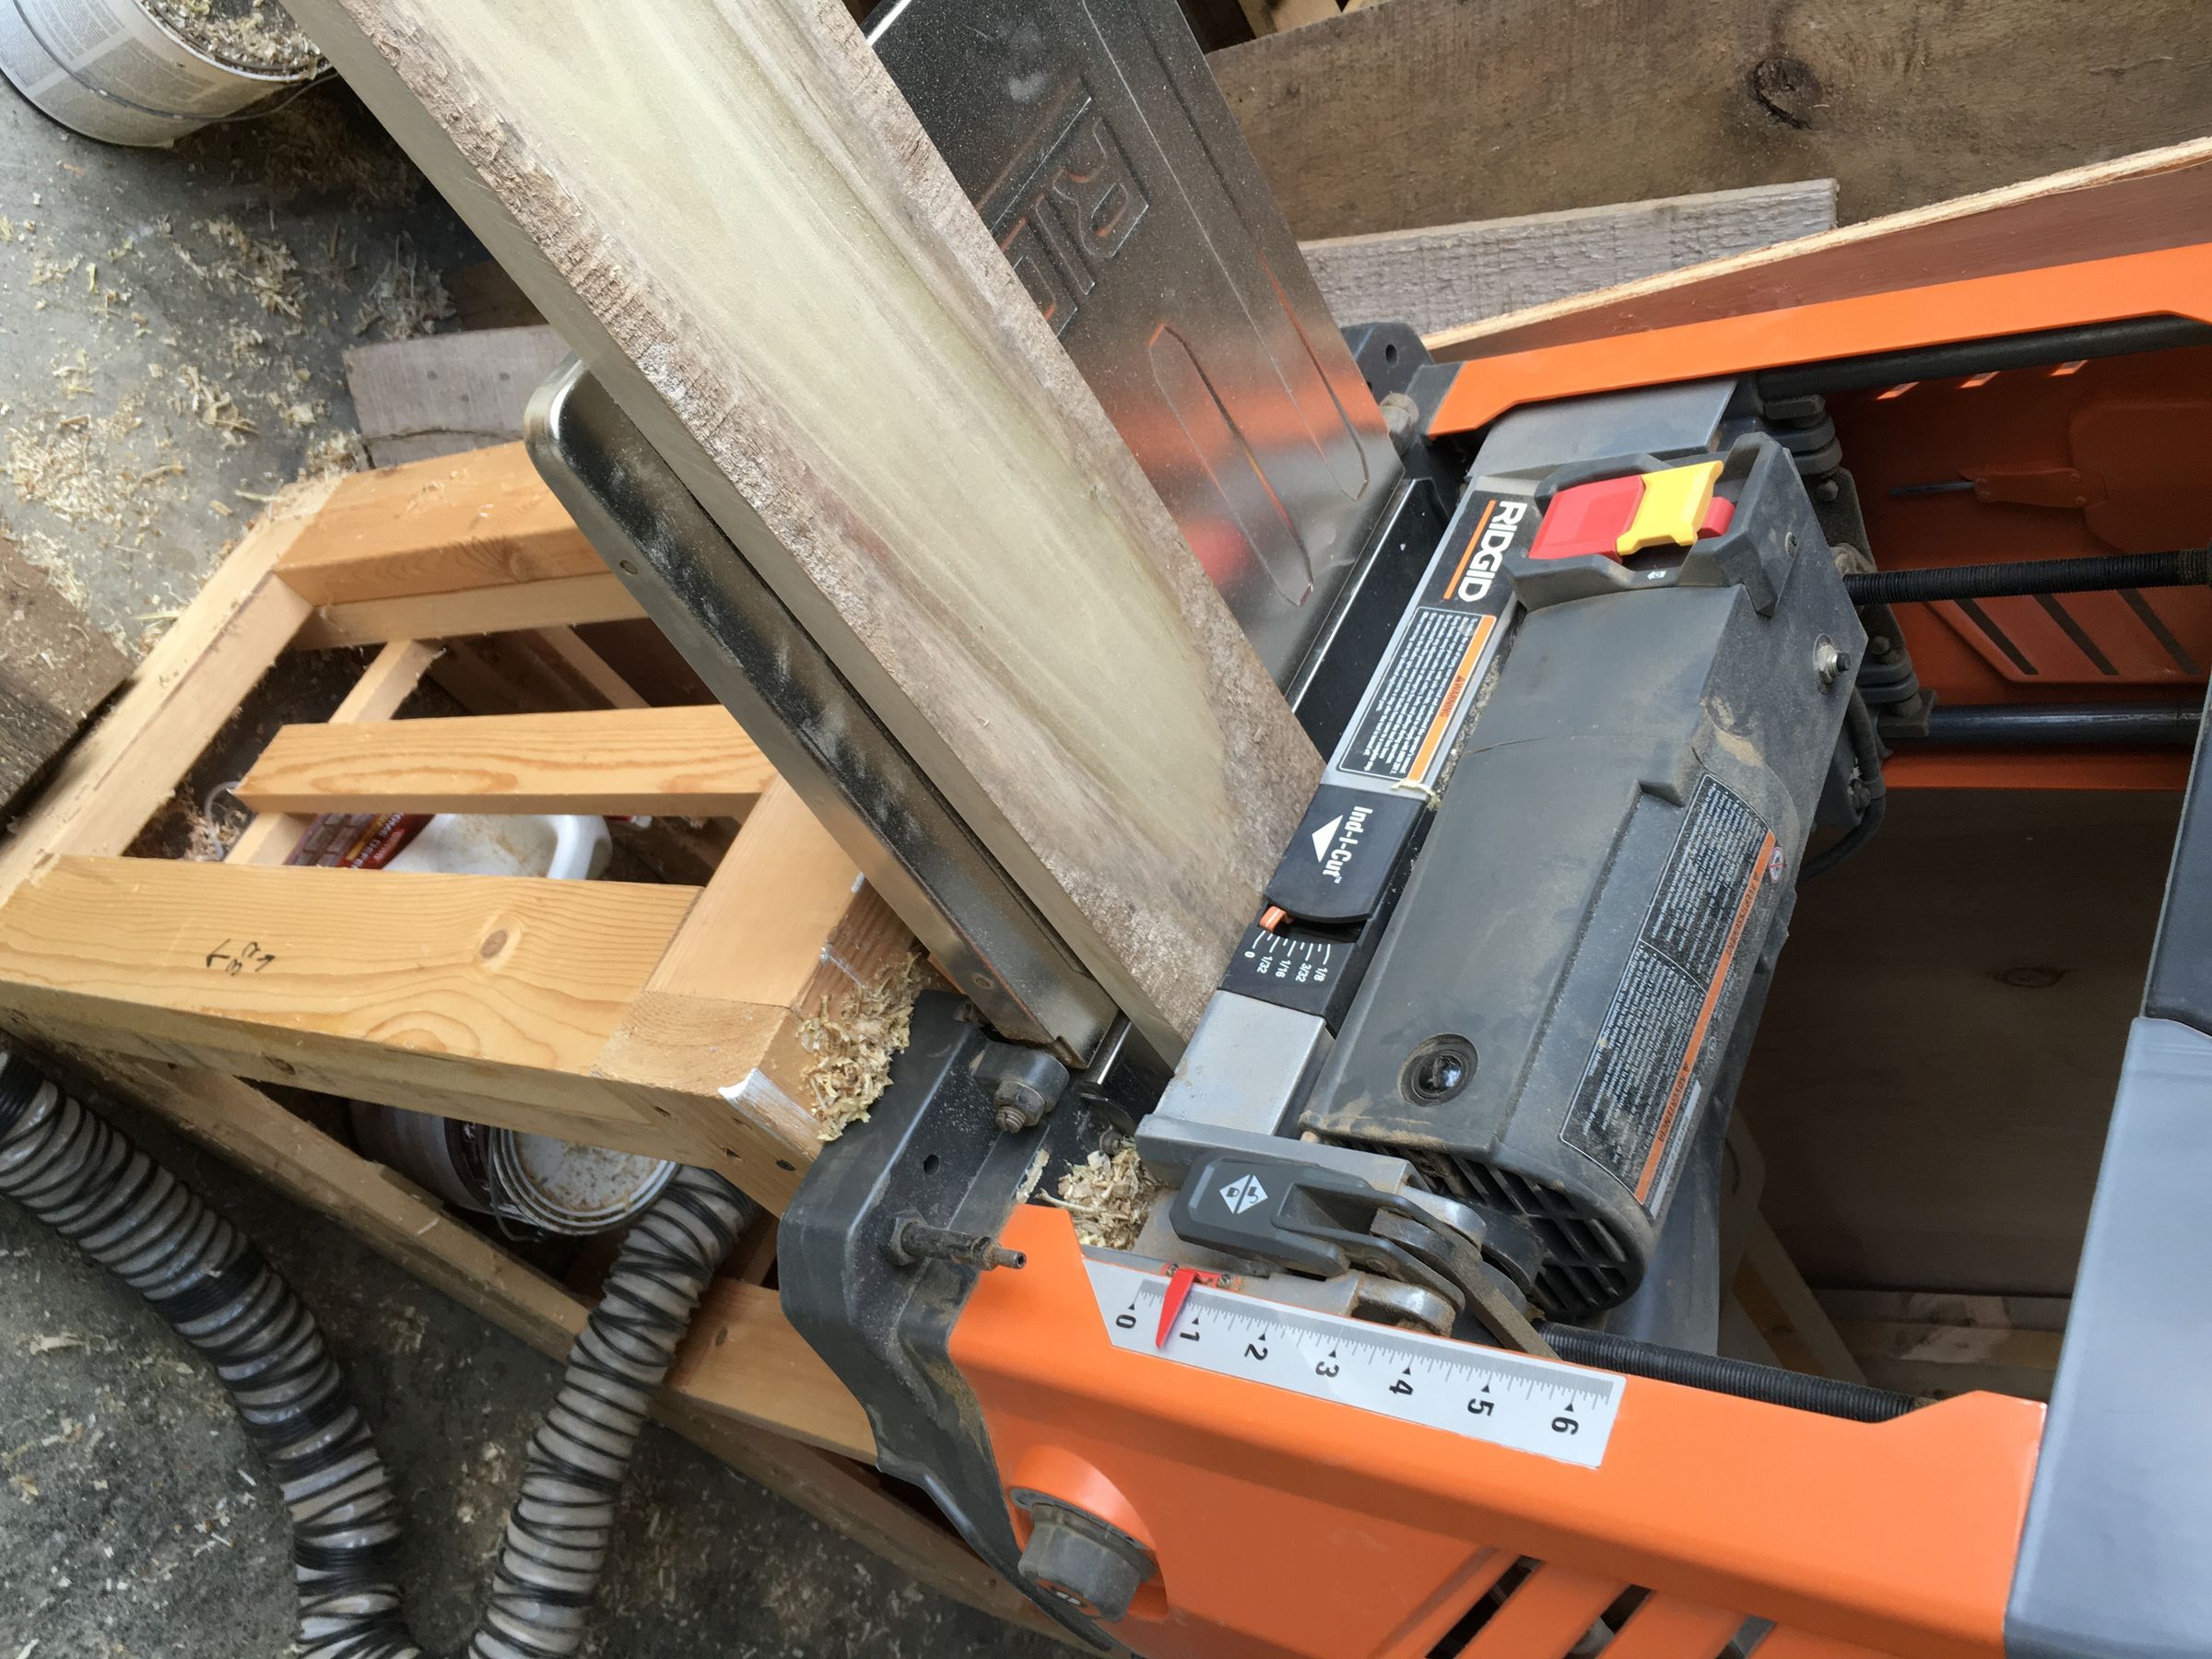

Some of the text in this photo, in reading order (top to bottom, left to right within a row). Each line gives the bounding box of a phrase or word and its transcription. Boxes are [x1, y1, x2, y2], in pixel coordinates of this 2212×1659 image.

[1457, 500, 1528, 603] RIDGID
[1440, 683, 1462, 718] WARNING
[1256, 956, 1274, 974] 1/32
[1276, 959, 1291, 978] 1/16
[1295, 963, 1312, 982] 3/32
[1313, 968, 1328, 982] 1/8
[1115, 1314, 1136, 1329] 0
[1180, 1331, 1201, 1342] 1
[1244, 1343, 1268, 1361] 2
[1315, 1360, 1340, 1378] 3
[1388, 1379, 1414, 1395] 4
[1467, 1398, 1495, 1417] 5
[1551, 1417, 1579, 1435] 6
